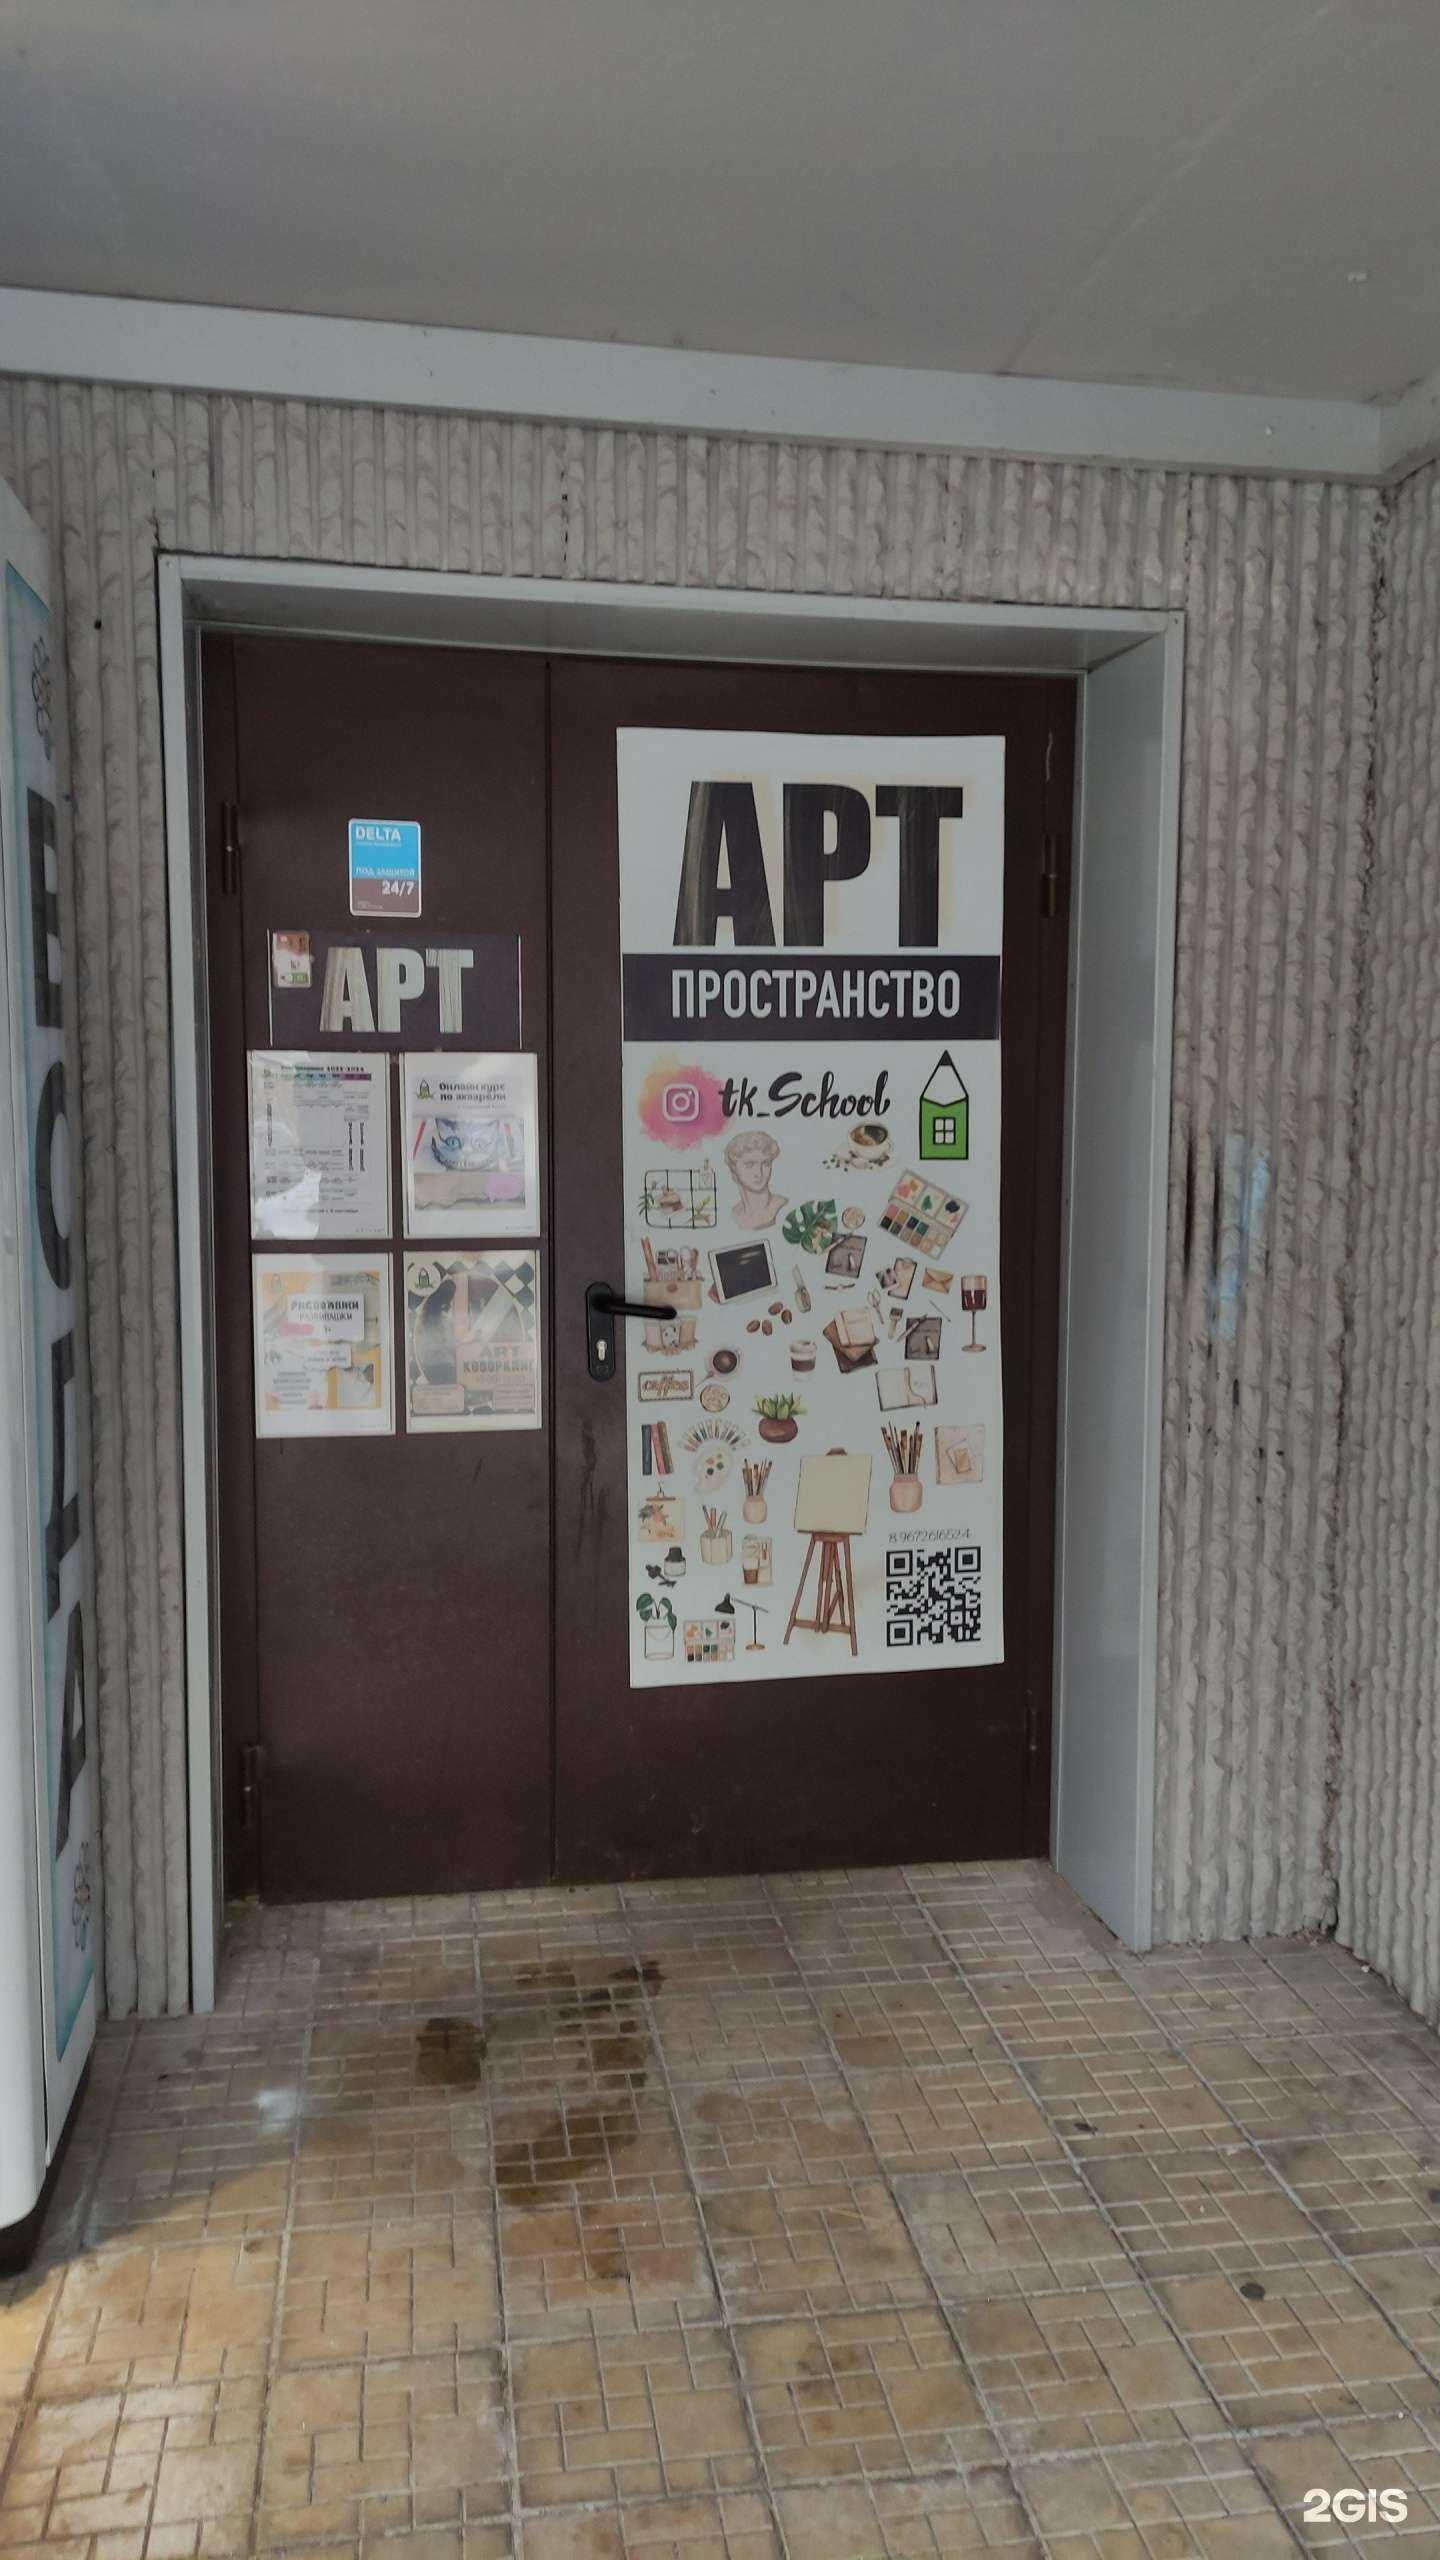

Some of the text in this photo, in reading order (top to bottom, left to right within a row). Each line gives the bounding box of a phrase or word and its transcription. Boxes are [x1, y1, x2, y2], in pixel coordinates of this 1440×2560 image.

[355, 826, 402, 842] DELTA
[382, 880, 415, 897] 24/7
[673, 781, 963, 948] АРТ
[319, 946, 475, 1033] АРТ
[671, 969, 961, 1019] ПРОСТРАНСТВО
[717, 1069, 891, 1119] tk_School
